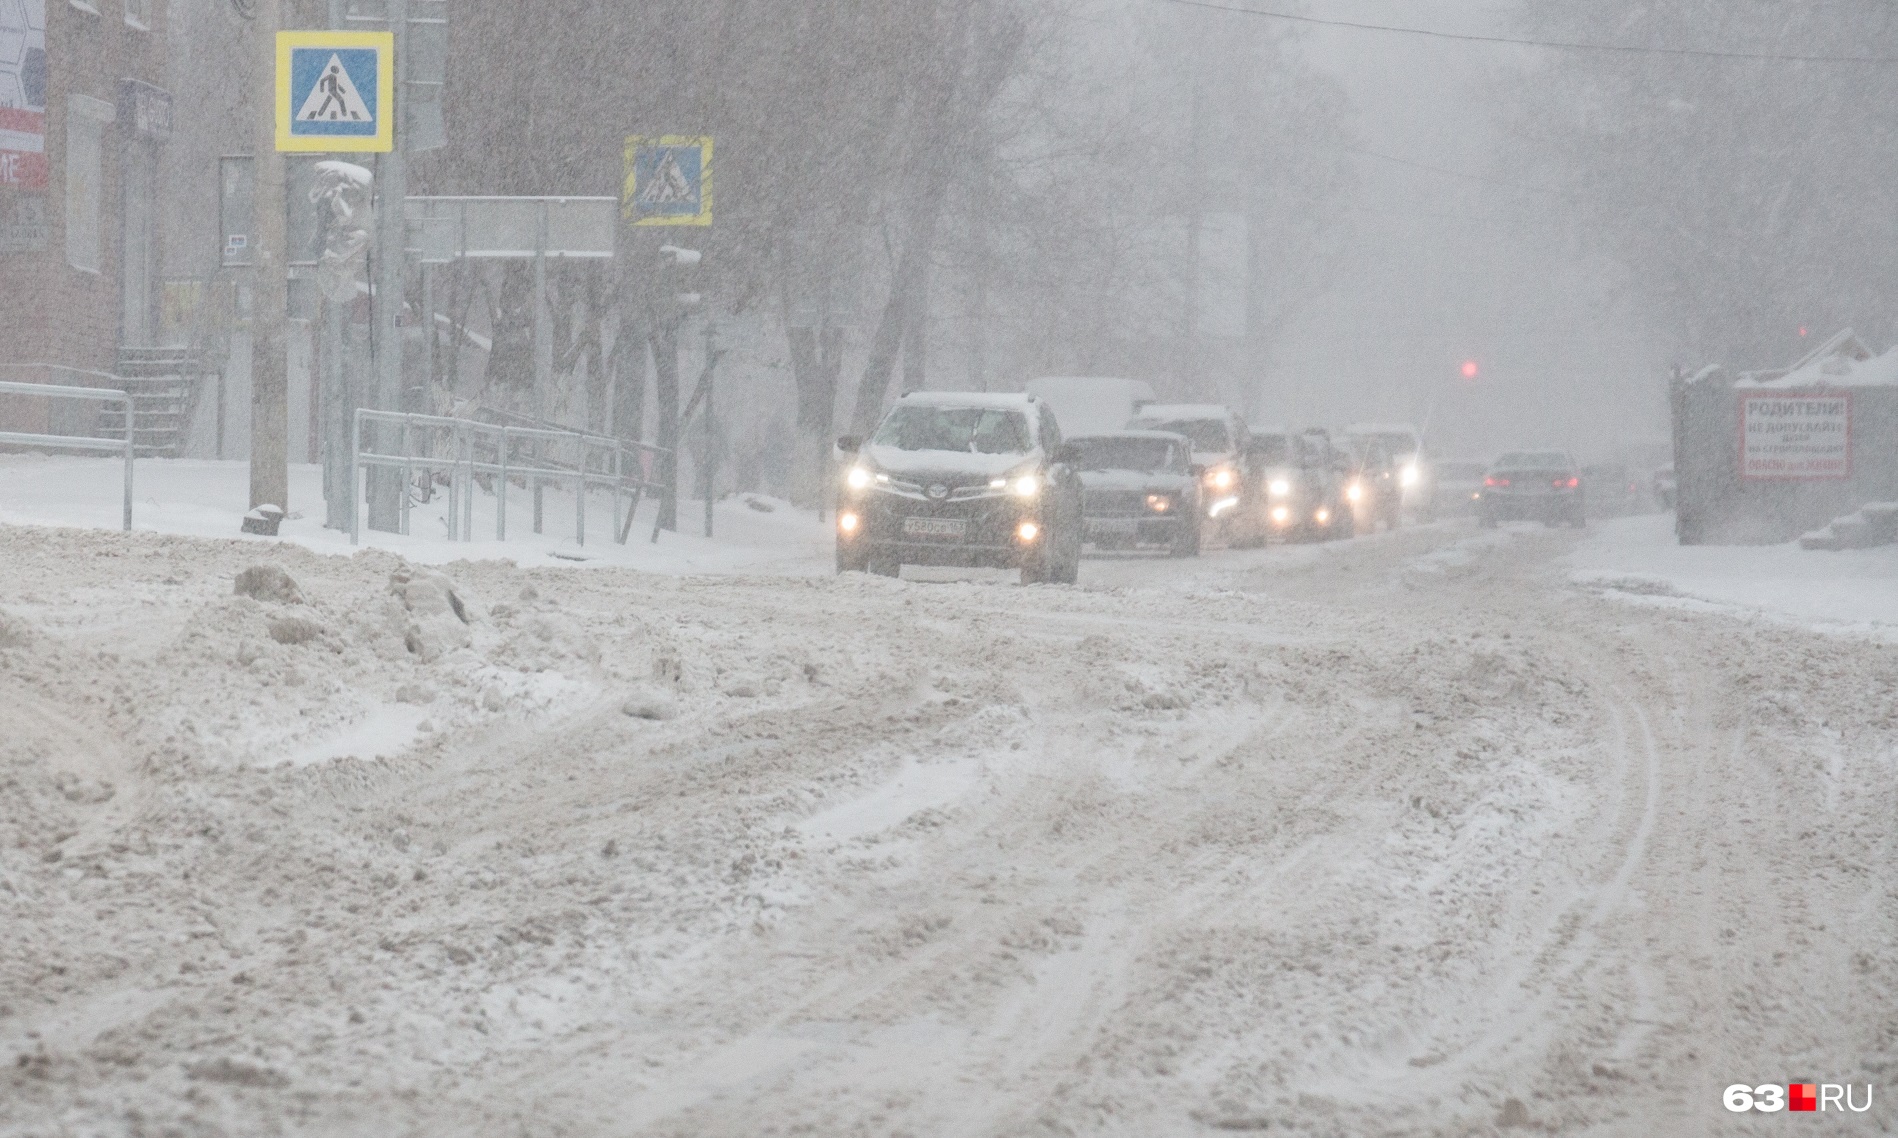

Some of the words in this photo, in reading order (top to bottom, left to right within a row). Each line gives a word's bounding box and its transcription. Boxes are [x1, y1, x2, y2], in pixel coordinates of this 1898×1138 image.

[1748, 401, 1844, 417] РОДИТЕЛИ!
[1748, 422, 1764, 433] НЕ
[1766, 421, 1843, 433] ДОПУСКАЙТЕ
